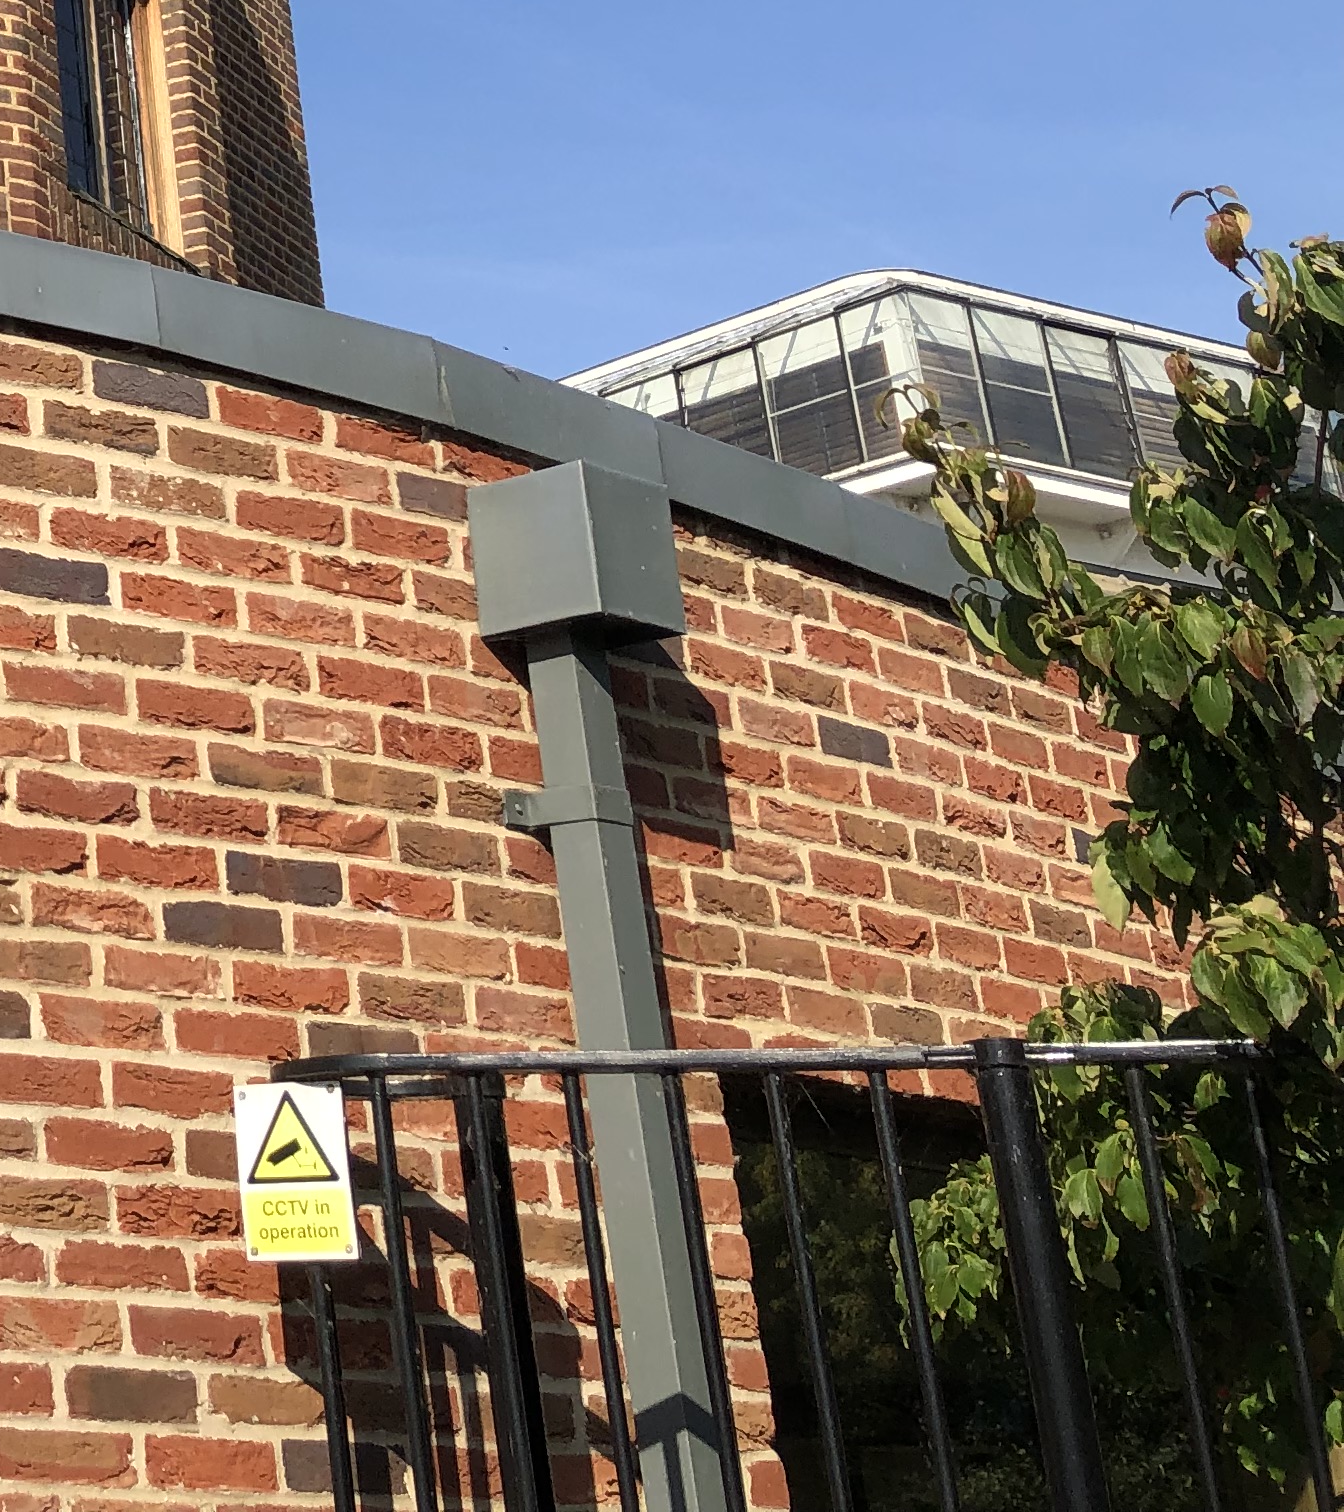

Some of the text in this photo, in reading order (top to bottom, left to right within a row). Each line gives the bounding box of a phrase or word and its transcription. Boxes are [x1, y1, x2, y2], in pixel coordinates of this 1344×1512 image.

[262, 1199, 330, 1216] CCTV in
[259, 1223, 340, 1243] operation
